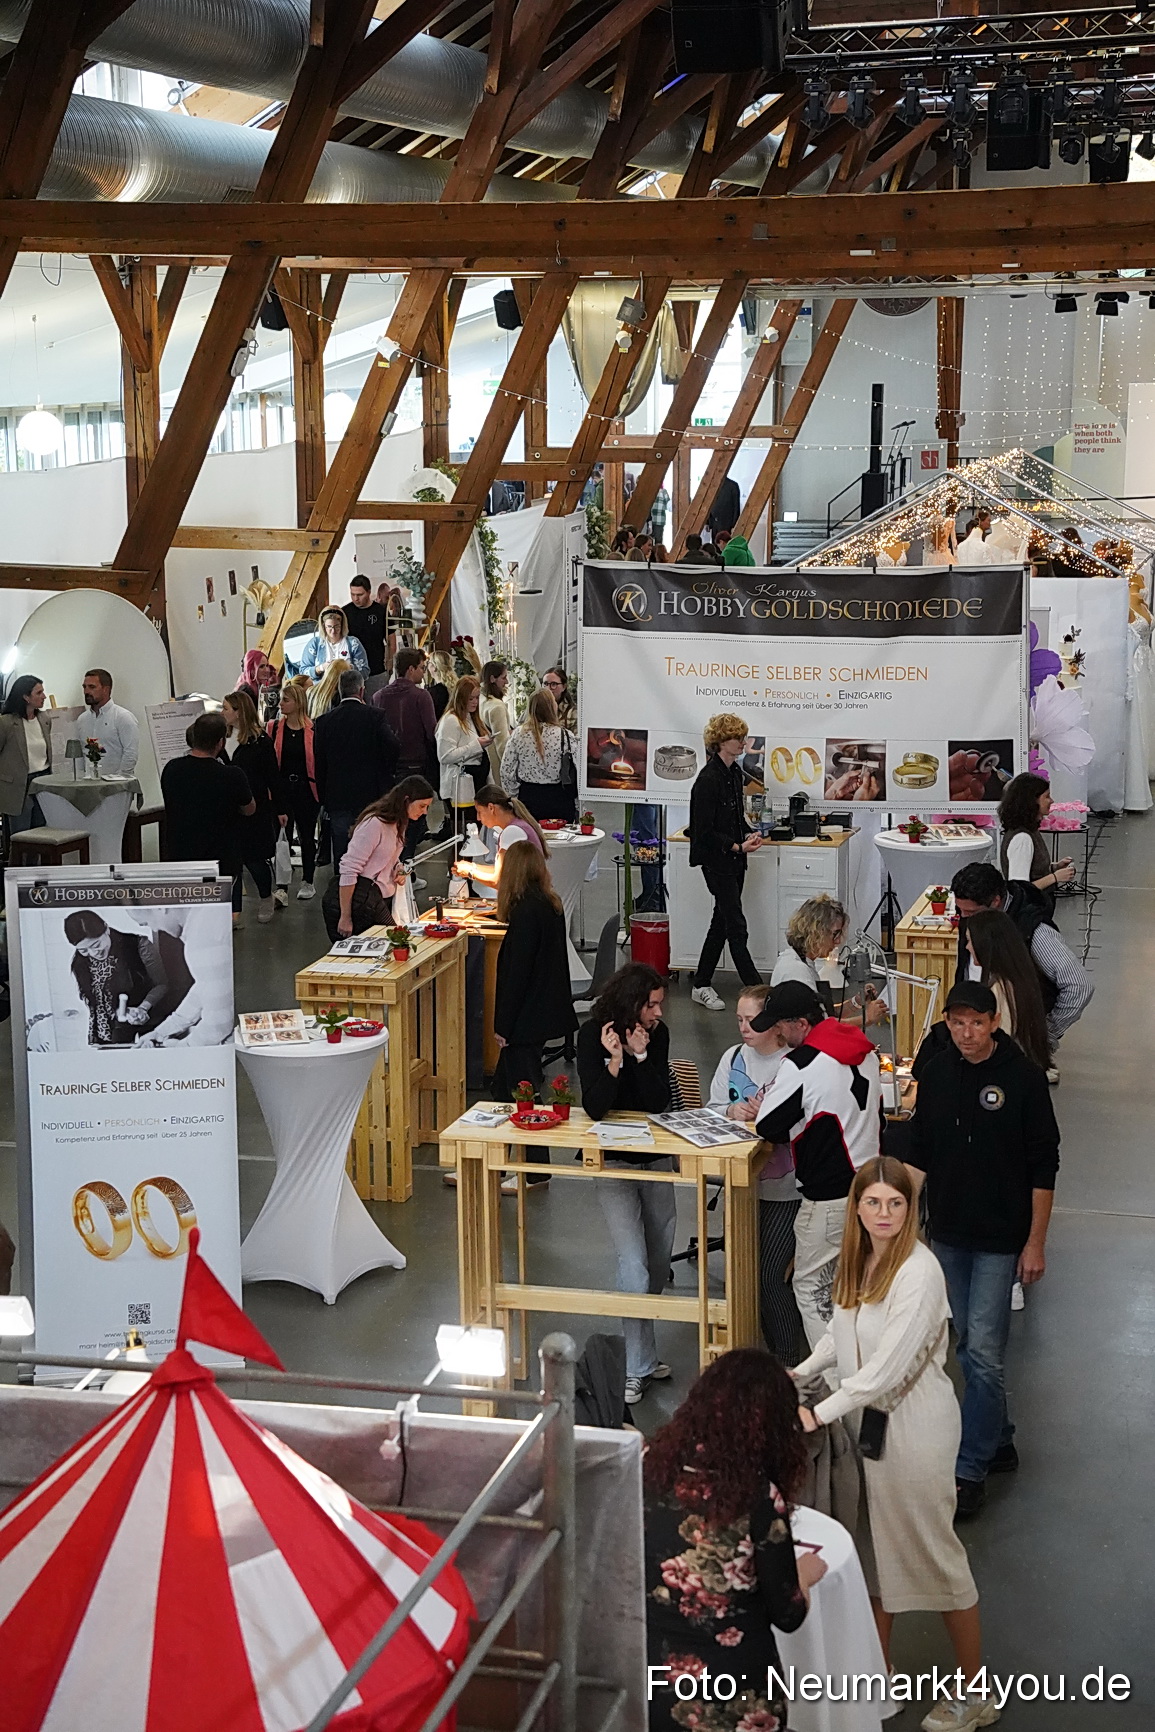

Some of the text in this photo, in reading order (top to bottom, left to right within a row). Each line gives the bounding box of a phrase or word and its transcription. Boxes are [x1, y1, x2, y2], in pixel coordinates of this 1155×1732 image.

[1074, 437, 1100, 445] people
[692, 582, 817, 600] Oliver Kargus
[658, 590, 983, 622] HOBBYGOLDSCHMIEDE
[664, 656, 929, 682] TRAURINGE SELBER SCHMIEDEN
[696, 685, 893, 700] INDIVIDUELL PERSÖNLICH EINZIGARTIG
[720, 700, 760, 708] Kompetenz
[768, 701, 801, 710] Erfahrung
[54, 885, 222, 900] HOBBYGOLDSCHMIEDE
[40, 1077, 225, 1096] TRAURINGE SELBER SCHMIEDEN
[41, 1114, 225, 1130] INDIVIDUELL PERSÖNLICH EINZIGARTIG
